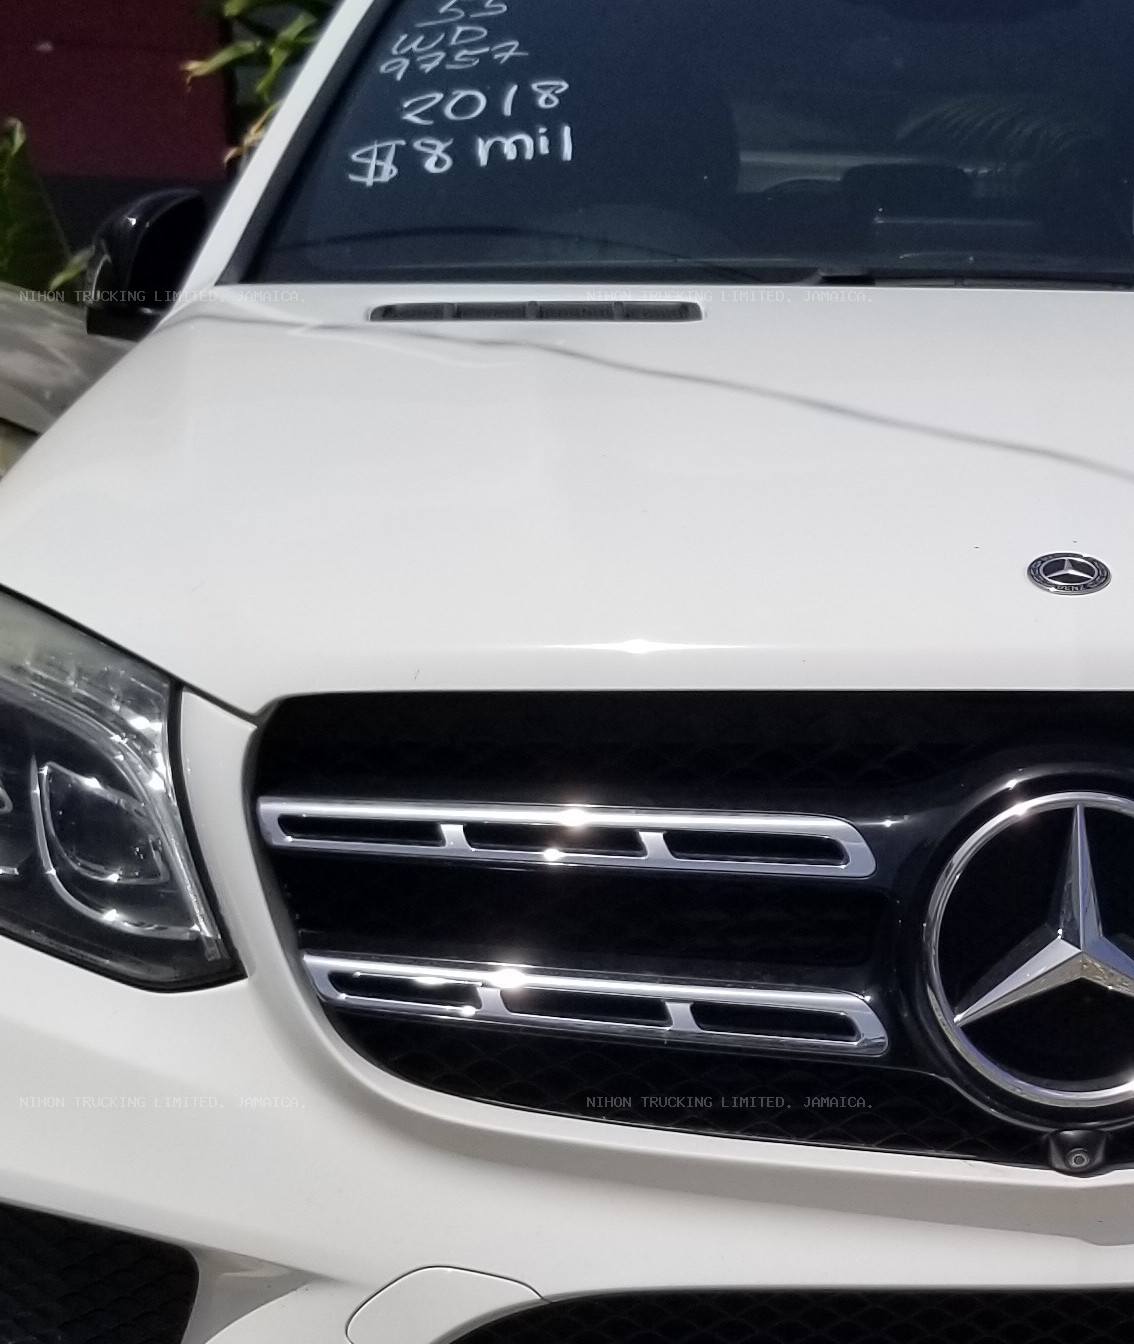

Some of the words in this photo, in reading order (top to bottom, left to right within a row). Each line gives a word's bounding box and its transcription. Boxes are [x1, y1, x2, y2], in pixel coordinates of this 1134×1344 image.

[379, 39, 529, 81] 9757
[401, 79, 569, 125] 2018
[477, 124, 573, 167] mil
